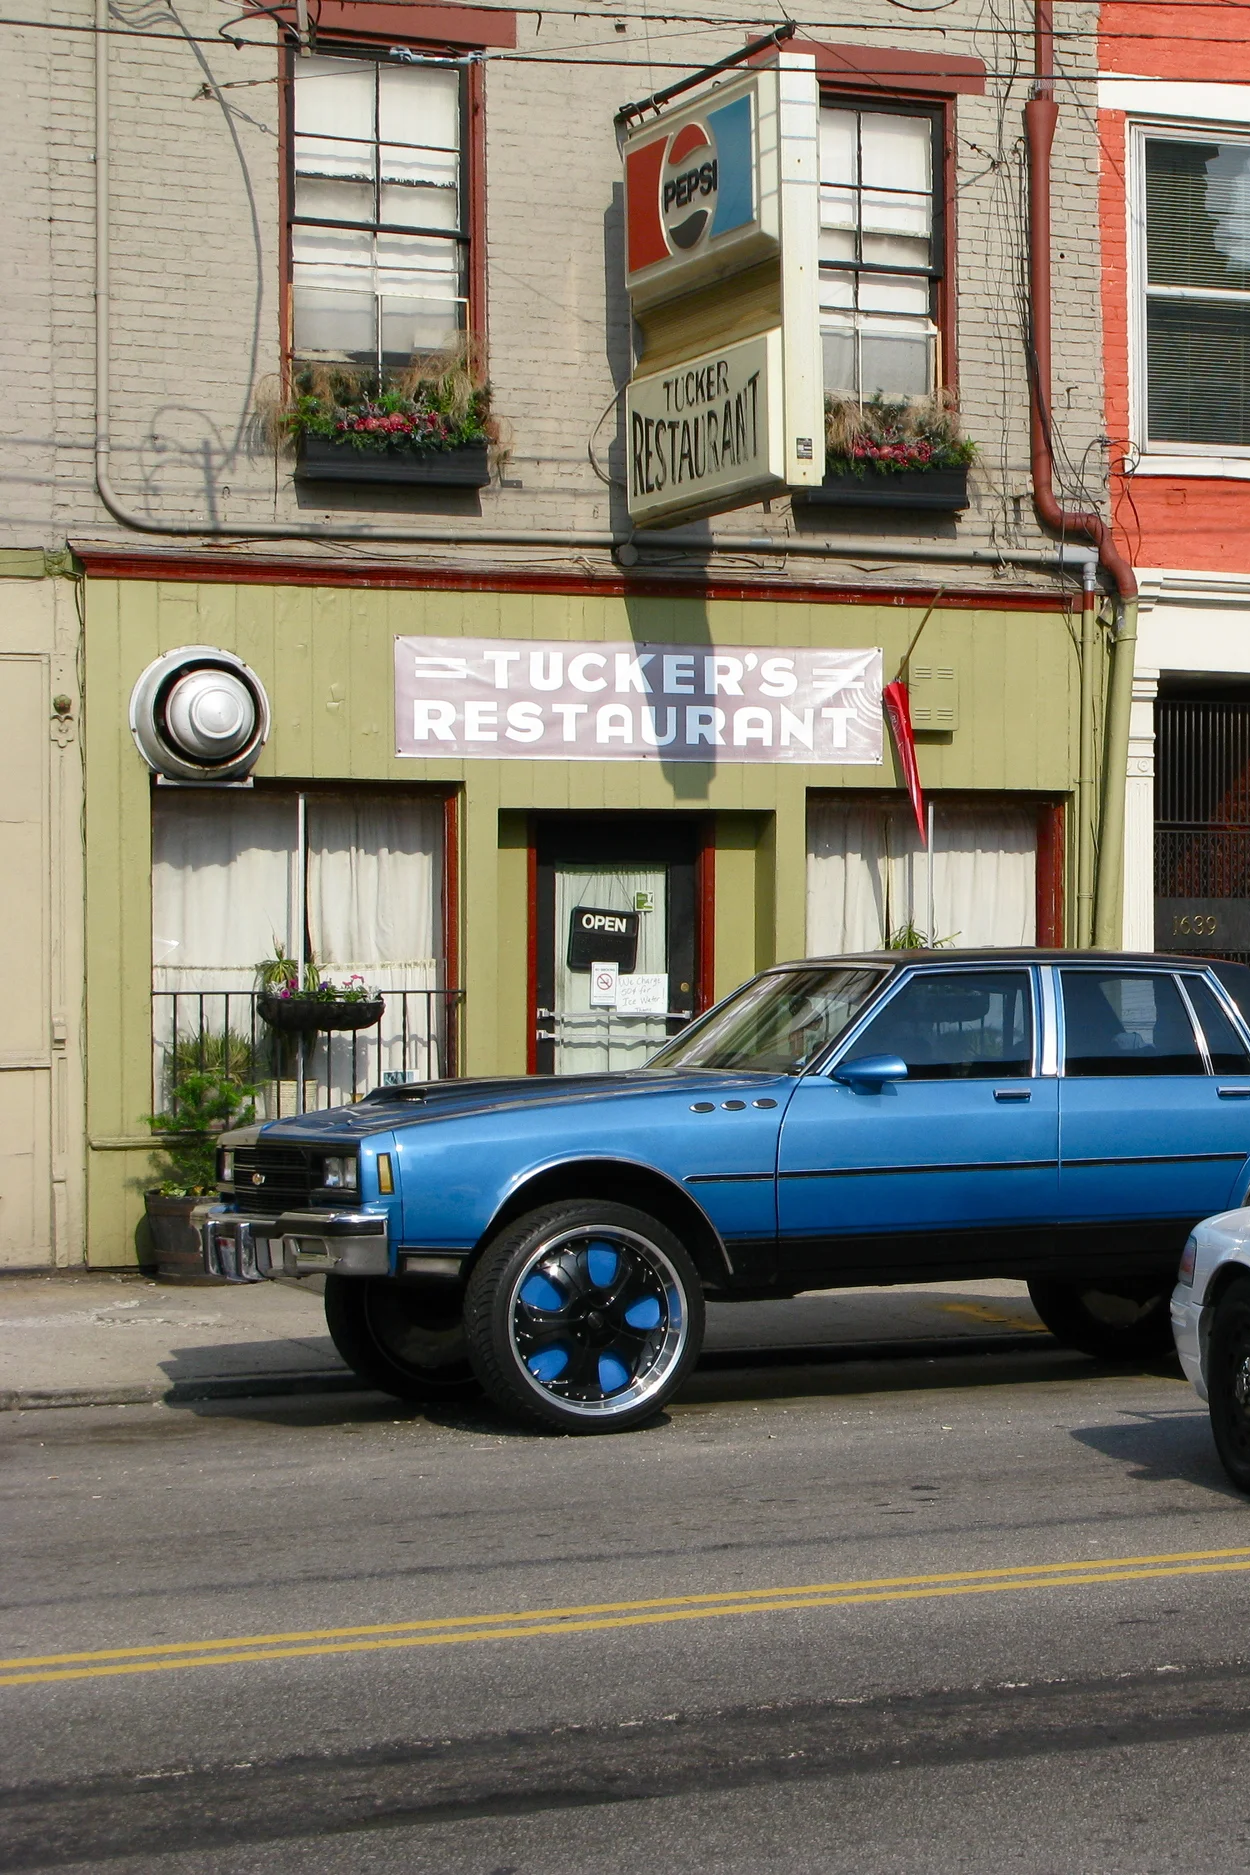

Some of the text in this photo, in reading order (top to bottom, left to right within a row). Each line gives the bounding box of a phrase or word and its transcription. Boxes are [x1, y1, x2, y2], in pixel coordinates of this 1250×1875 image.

[664, 159, 718, 213] PEPSI
[663, 360, 729, 413] TUCKER
[632, 370, 760, 497] RESTAURANT
[482, 651, 799, 697] TUCKER'S
[412, 699, 859, 749] RESTAURANT
[581, 913, 627, 933] OPEN
[1172, 915, 1217, 936] 1639
[618, 976, 662, 987] We Charge
[639, 985, 651, 994] for
[622, 997, 636, 1007] Ice
